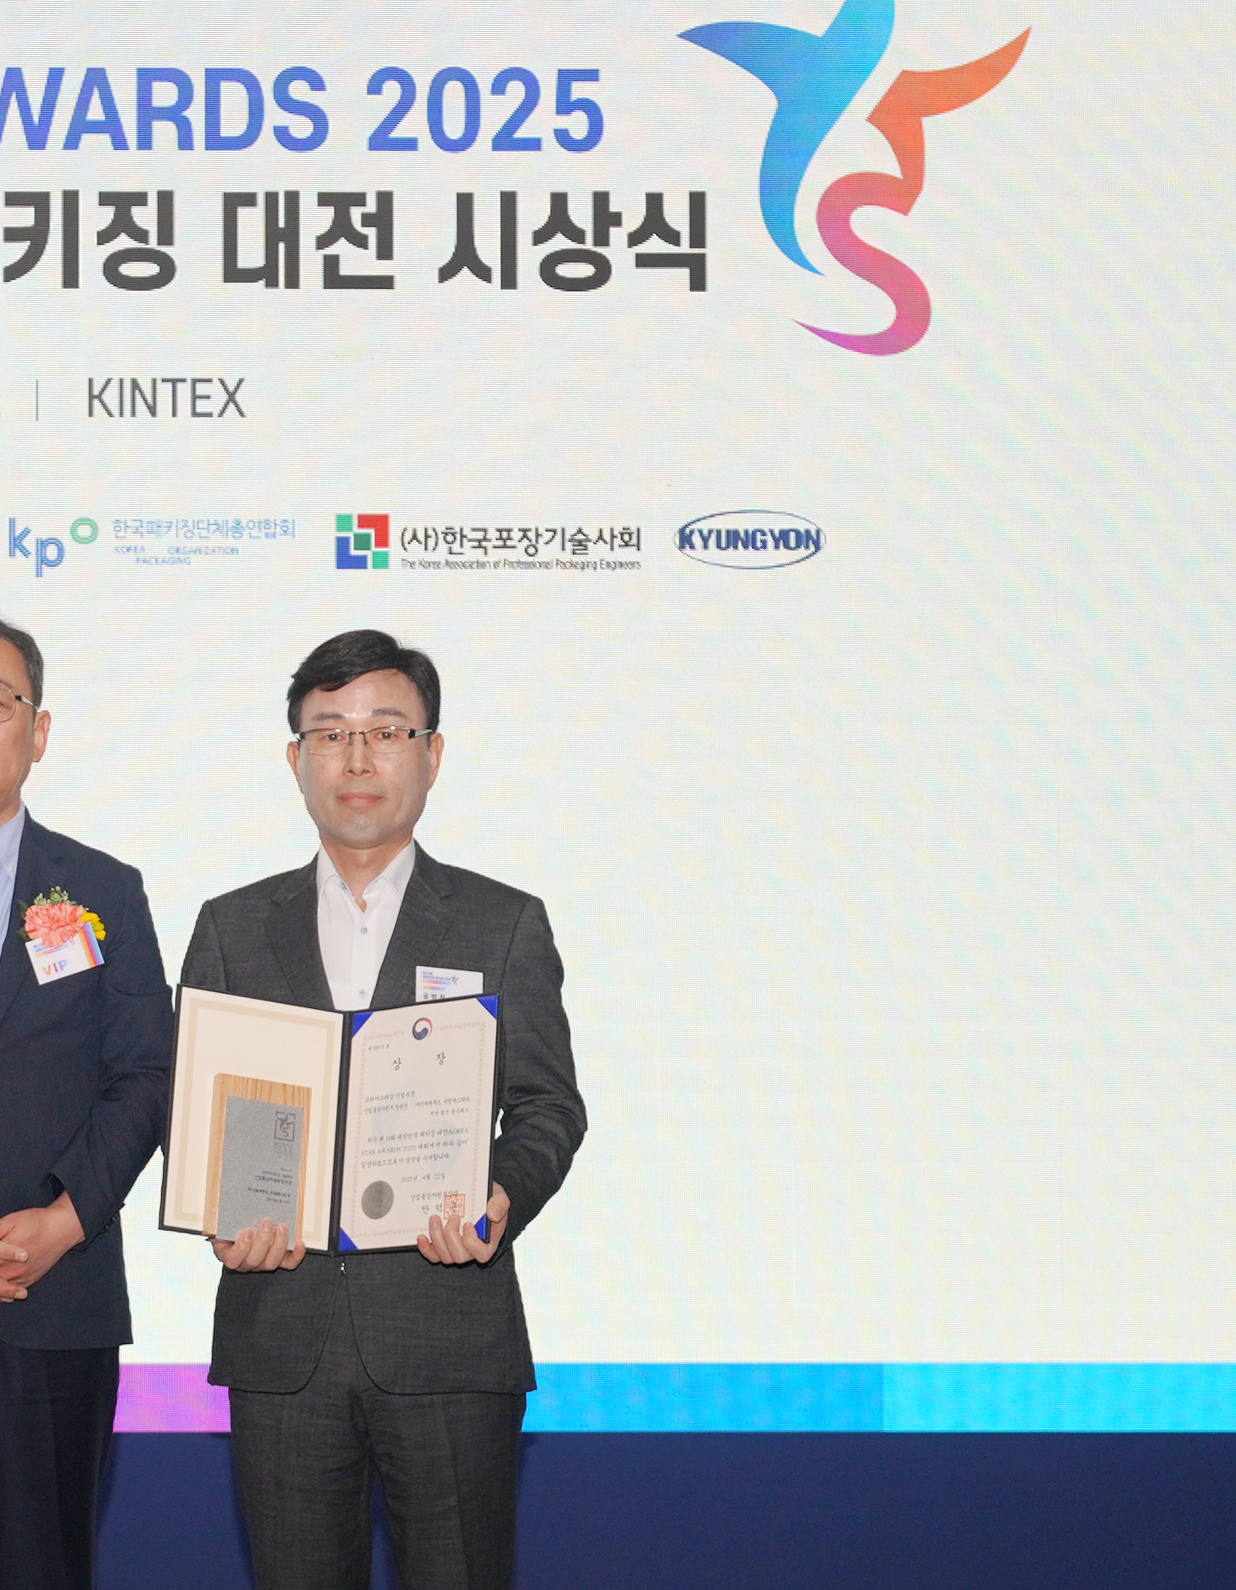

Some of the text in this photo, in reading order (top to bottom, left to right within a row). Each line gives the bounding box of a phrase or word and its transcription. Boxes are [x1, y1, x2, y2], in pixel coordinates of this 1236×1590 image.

[367, 66, 604, 153] 2025
[222, 190, 396, 290] 대전
[438, 191, 707, 292] 시상식
[87, 377, 247, 418] KINTEX
[401, 526, 641, 557] (사)한국포장기술사회
[678, 527, 821, 551] KYUNGYON
[42, 960, 68, 975] VIP
